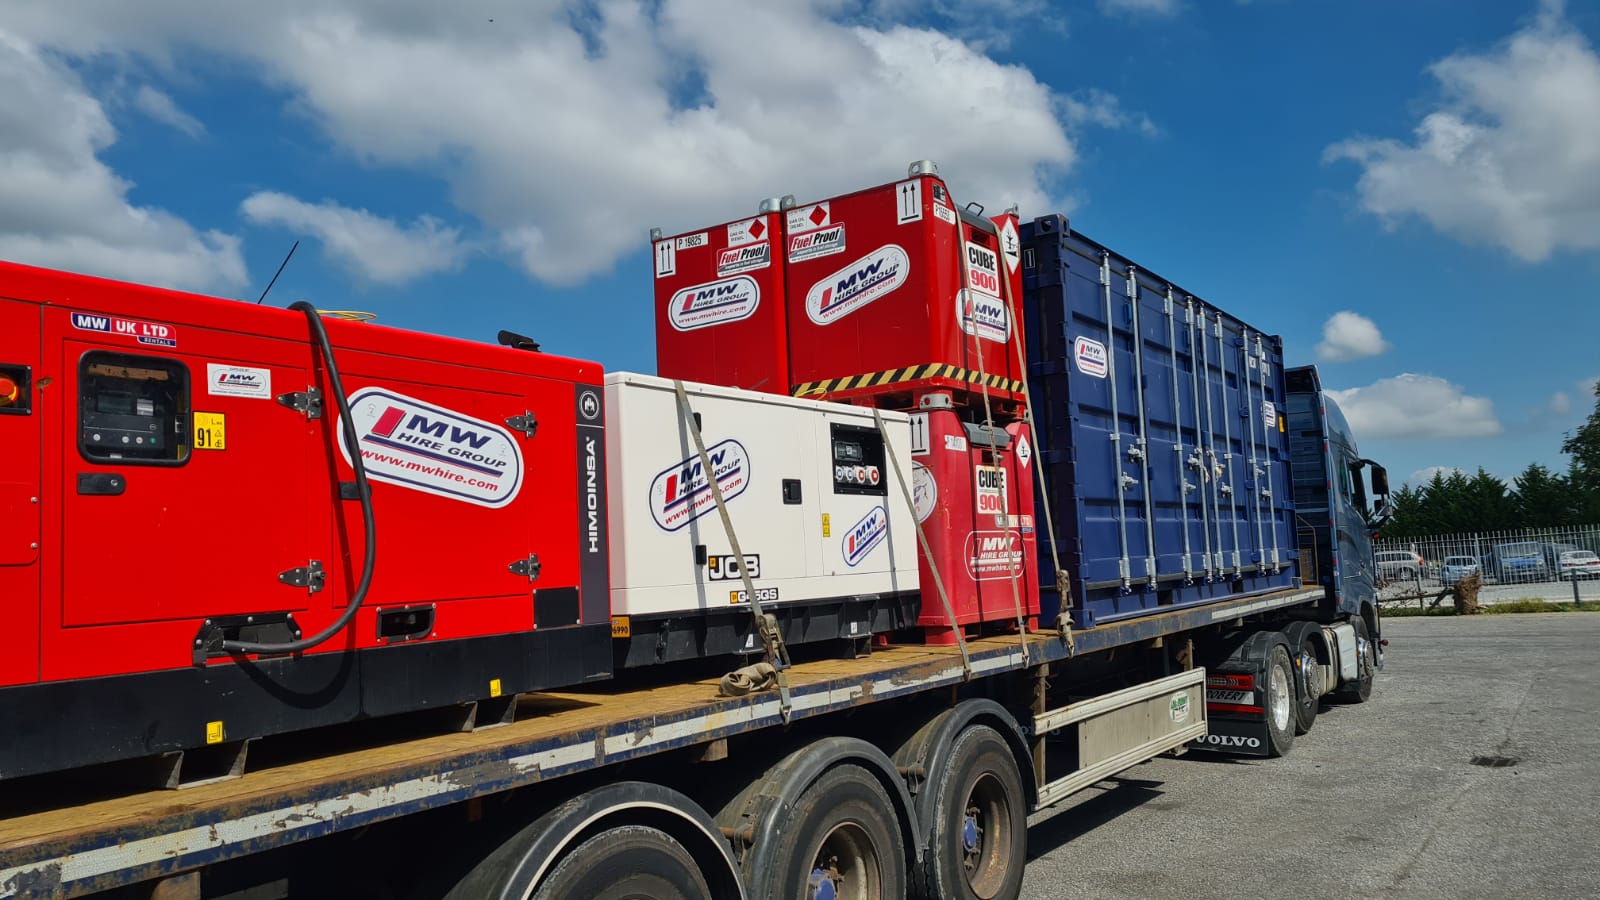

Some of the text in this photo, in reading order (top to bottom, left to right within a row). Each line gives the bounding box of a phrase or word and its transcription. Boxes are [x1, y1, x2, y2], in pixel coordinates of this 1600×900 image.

[679, 235, 702, 249] P 19825
[792, 235, 813, 250] Fuel
[813, 228, 840, 245] Proof
[721, 250, 741, 264] Fuel
[741, 244, 765, 260] Proof
[969, 246, 995, 271] CUBE
[834, 263, 900, 303] HIRE GROUP
[837, 258, 884, 294] MW
[971, 269, 996, 292] 900
[693, 291, 750, 309] HIRE GROUP
[696, 283, 739, 301] MW
[975, 303, 1001, 318] MW
[77, 315, 168, 337] MW UK LTD
[144, 337, 171, 346] RENTALS
[1085, 345, 1101, 355] MW
[198, 427, 211, 448] 91
[406, 414, 492, 449] MW
[396, 432, 507, 468] HIRE GROUP
[359, 449, 499, 492] www.mwhire.com
[679, 458, 741, 496] HIRE ROUP
[681, 449, 726, 485] MW
[979, 470, 1004, 488] CUBE
[585, 439, 599, 553] HIMOINSA
[665, 478, 742, 524] www.mwhi.com
[856, 512, 877, 541] MW
[983, 537, 1015, 551] MW
[980, 551, 1023, 560] HIRE GRUP
[710, 556, 759, 579] JCB
[738, 588, 777, 603] G5GS
[1196, 734, 1260, 748] VOLVO
